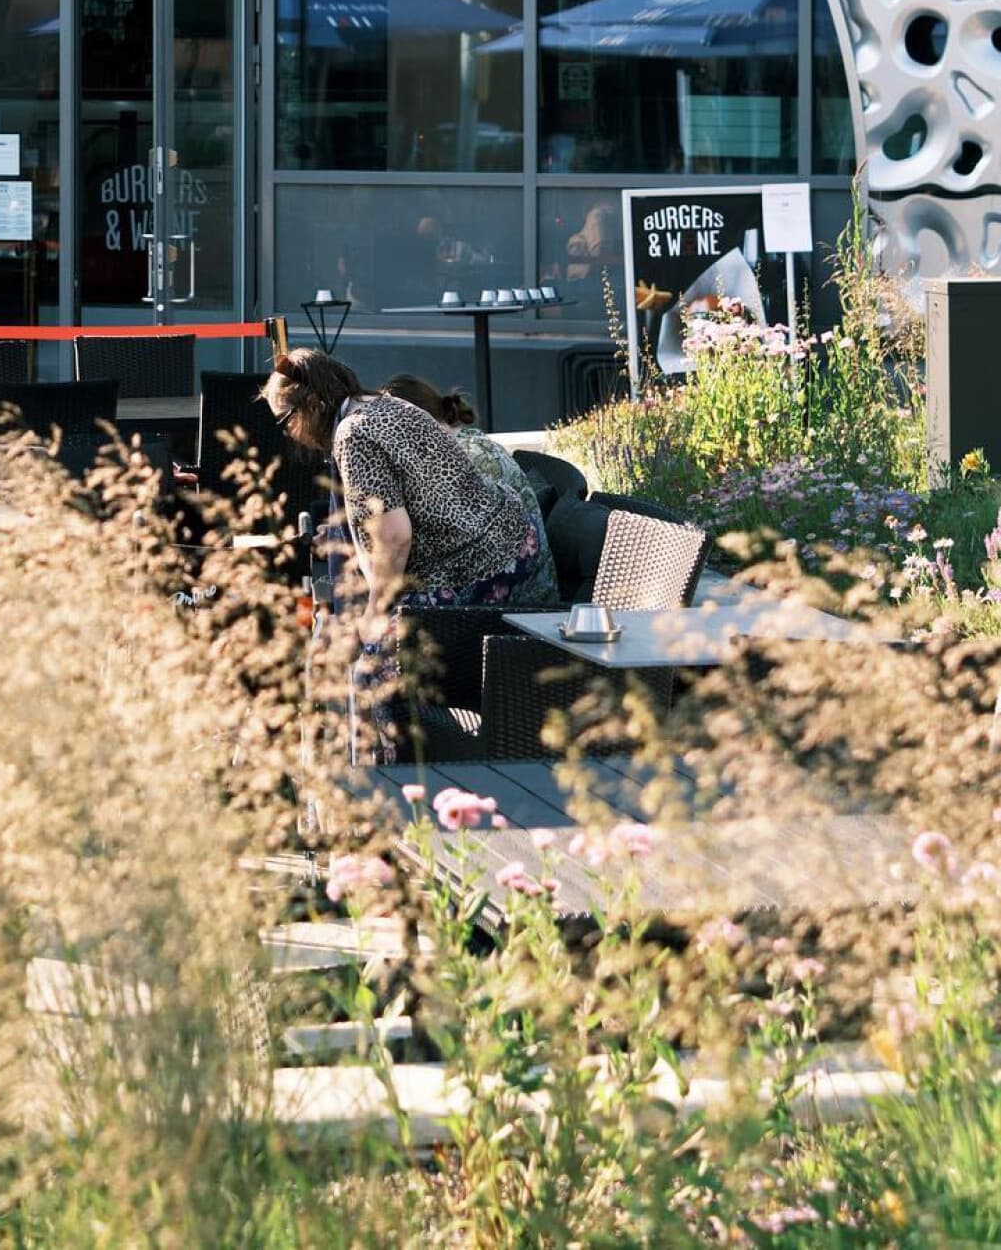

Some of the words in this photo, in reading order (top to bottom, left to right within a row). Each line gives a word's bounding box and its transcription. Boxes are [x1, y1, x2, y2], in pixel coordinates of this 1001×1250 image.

[101, 163, 208, 204] BURRS
[105, 209, 121, 251] &
[129, 209, 201, 252] WNE
[643, 204, 725, 231] BURGERS
[647, 232, 662, 258] &
[665, 229, 721, 257] WNE
